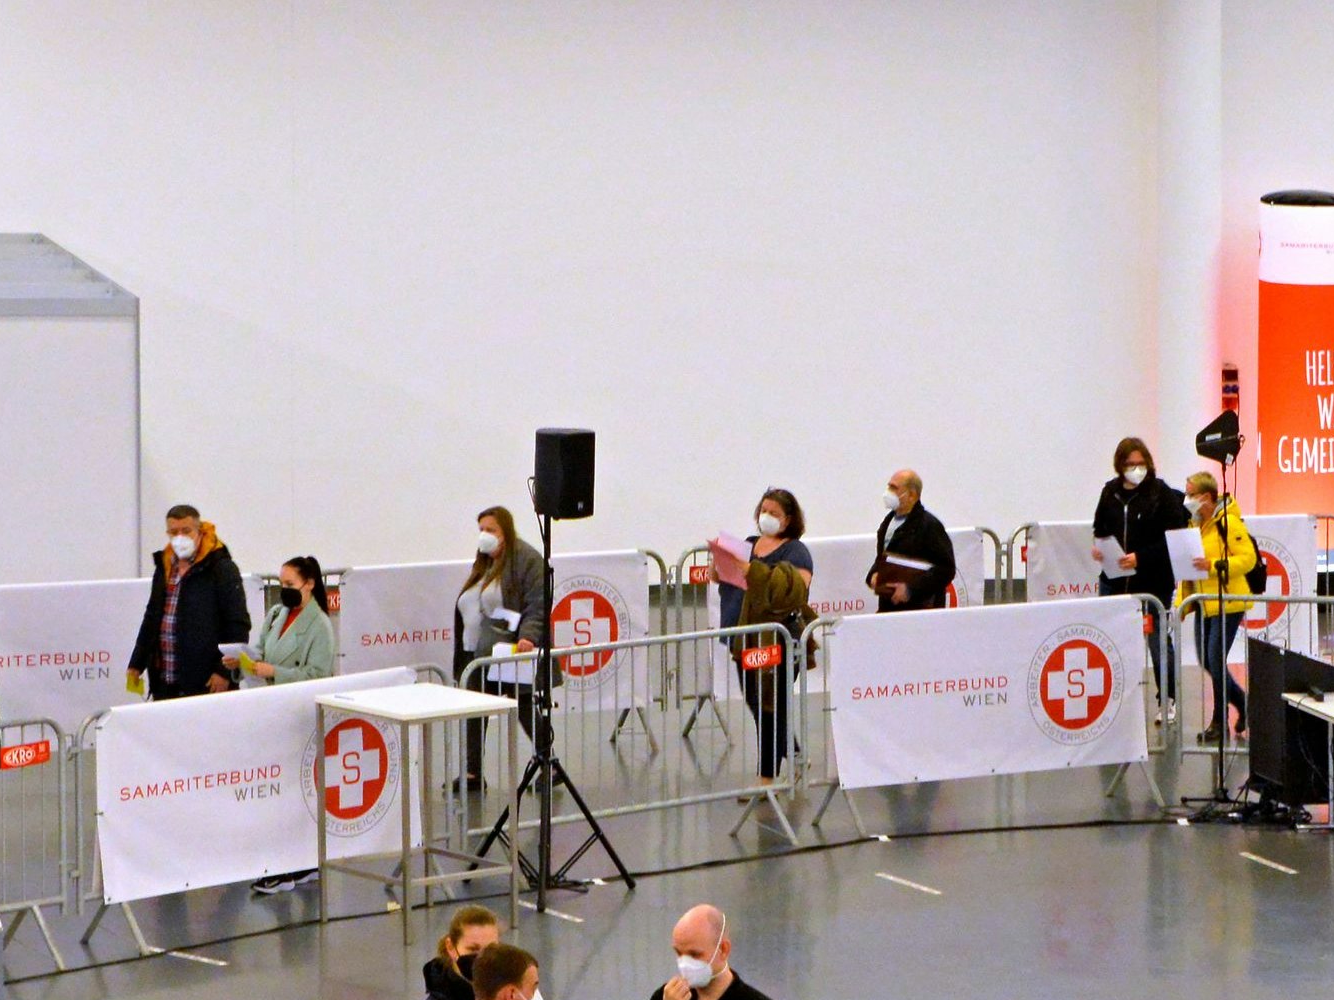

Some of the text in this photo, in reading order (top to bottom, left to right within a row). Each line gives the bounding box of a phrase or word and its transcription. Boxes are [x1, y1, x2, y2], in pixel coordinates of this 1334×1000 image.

[361, 628, 451, 647] SAMARITE
[573, 619, 591, 646] S
[59, 667, 110, 680] WIEN
[1067, 669, 1085, 698] S
[852, 676, 1008, 700] SAMARITERBUND
[963, 692, 1008, 707] WIEN
[3, 749, 35, 765] EKRO
[342, 751, 361, 785] S
[120, 764, 282, 801] SAMARITERBUND
[234, 782, 281, 802] WIEN
